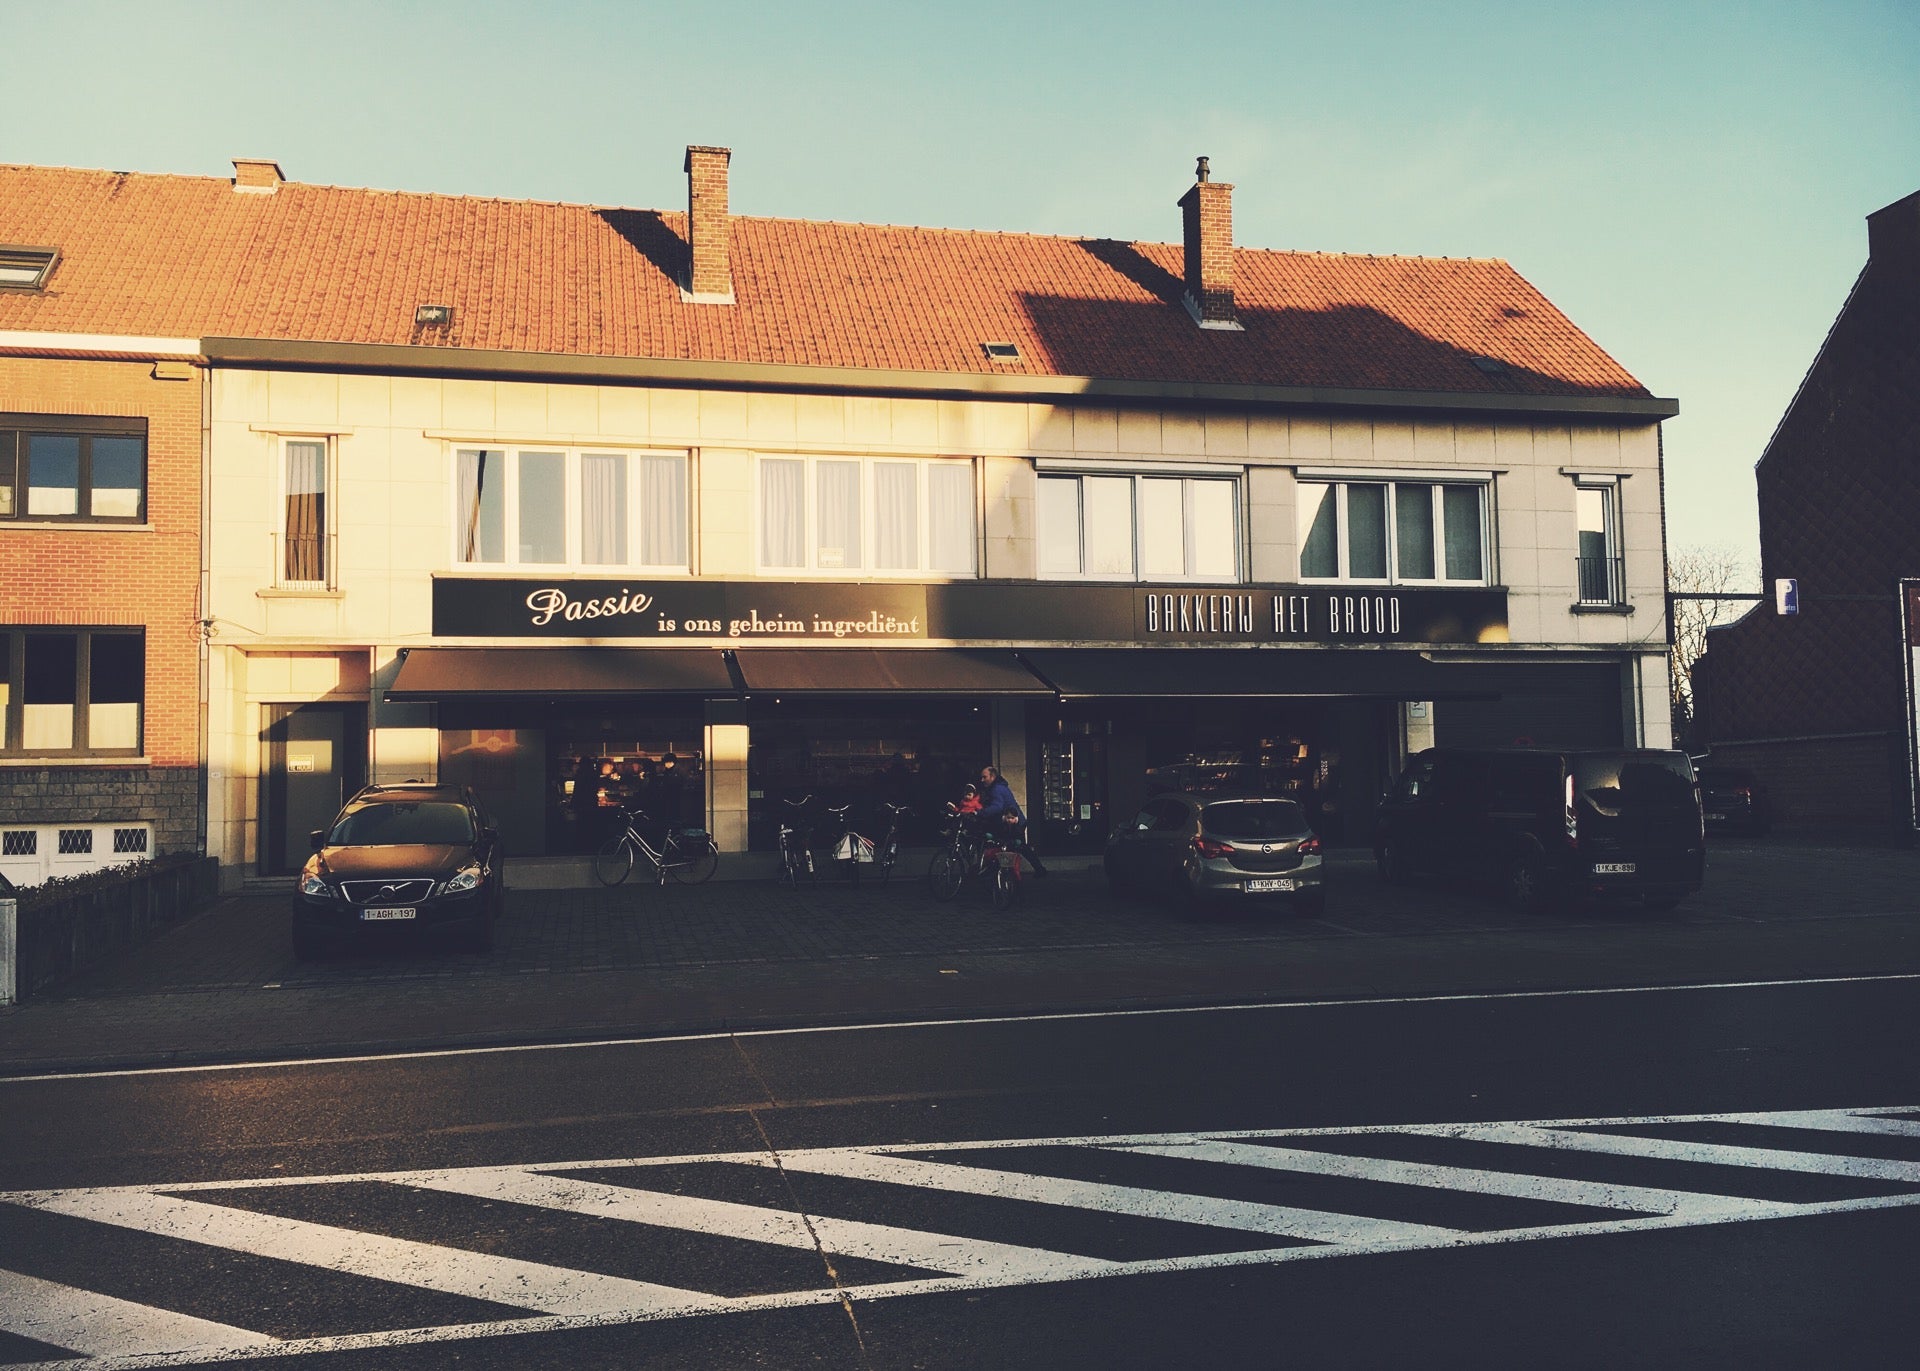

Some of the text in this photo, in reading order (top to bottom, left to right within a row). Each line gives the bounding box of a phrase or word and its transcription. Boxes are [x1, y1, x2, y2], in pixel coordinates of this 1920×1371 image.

[526, 588, 653, 626] Passie
[658, 609, 920, 637] is ons geheim ingrediënt
[1148, 594, 1399, 634] BAKKERIJ HET BROOD
